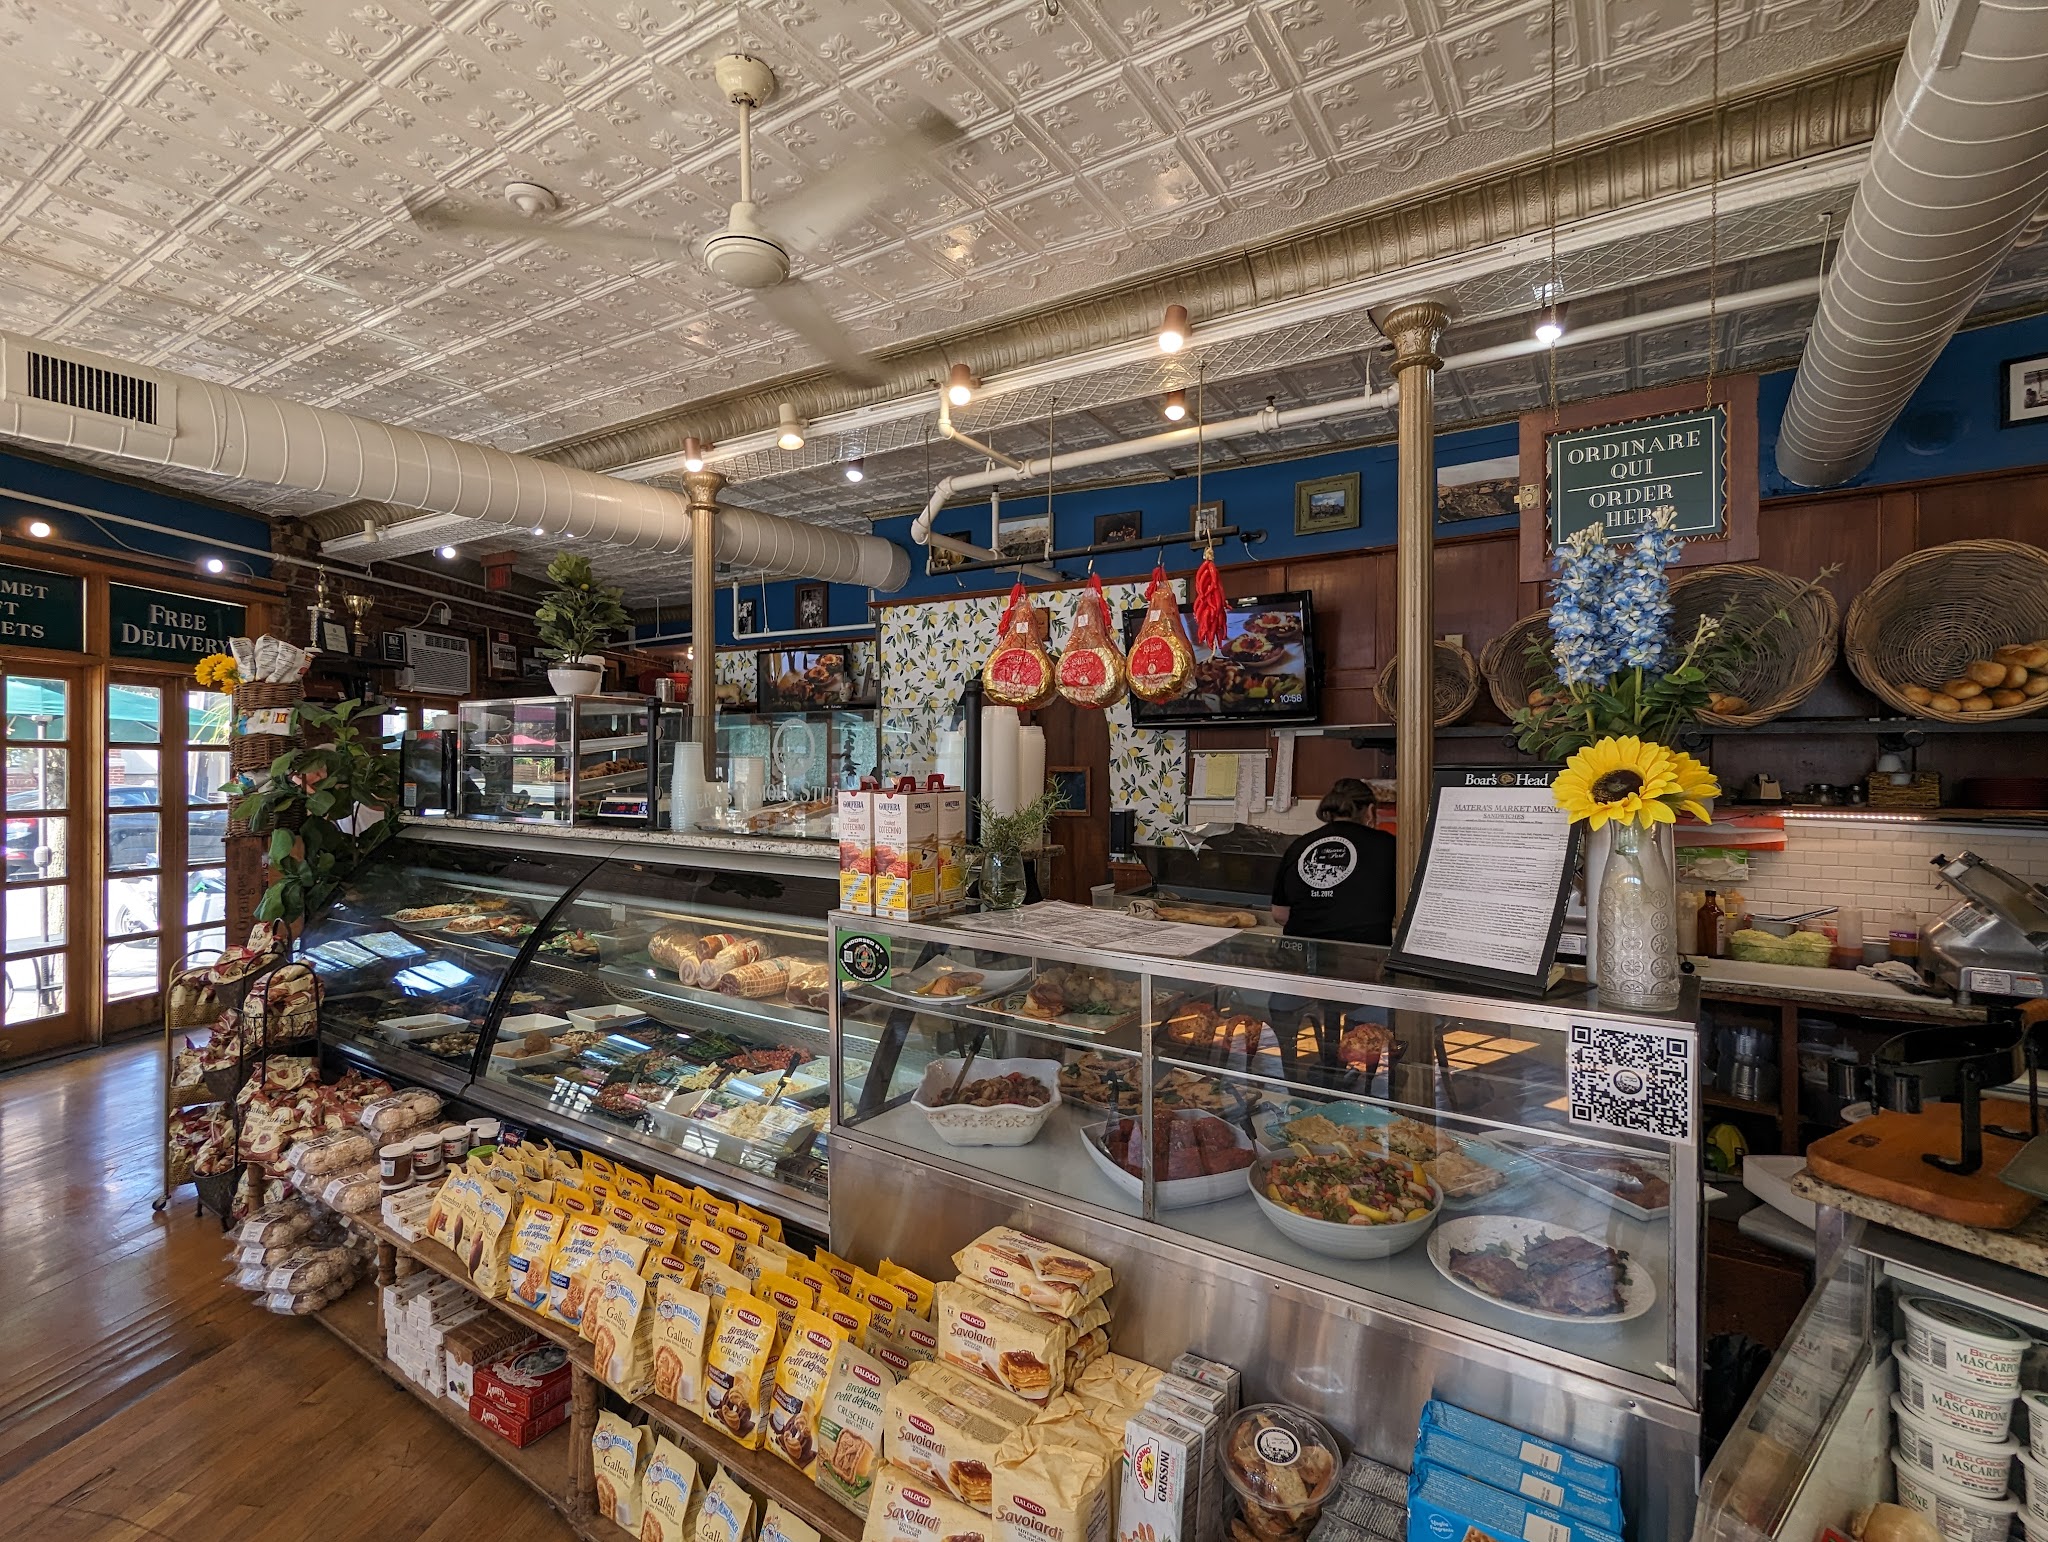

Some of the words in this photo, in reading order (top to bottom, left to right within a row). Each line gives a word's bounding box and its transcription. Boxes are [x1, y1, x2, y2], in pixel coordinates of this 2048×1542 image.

[1567, 430, 1701, 465] ORDINARE
[1610, 458, 1653, 480] QUI
[1588, 483, 1675, 509] ORDER
[1605, 505, 1657, 528] HER
[150, 603, 207, 632] FREE
[121, 622, 233, 655] DELIVERY
[1280, 694, 1303, 703] 10:58
[1465, 773, 1498, 786] Boar's
[1515, 772, 1549, 787] Head
[878, 803, 901, 814] GOLFERA
[1453, 804, 1494, 812] MATERA'S
[1494, 805, 1532, 813] MARKET
[878, 826, 902, 835] COTECHINO
[843, 937, 875, 950] ENDORSED
[874, 943, 885, 954] BY
[567, 1199, 584, 1211] BALOCCO
[536, 1210, 553, 1221] BALOCCO
[615, 1209, 633, 1221] BALOCCO
[527, 1223, 551, 1234] Breakfast
[579, 1225, 599, 1236] BALOCCO
[646, 1222, 665, 1235] BALOCCO
[728, 1227, 747, 1240] BALOCCO
[571, 1239, 595, 1249] Breakfast
[701, 1240, 720, 1255] BALOCCO
[662, 1257, 684, 1271] BALOCCO
[989, 1267, 1009, 1278] BALOCCO
[775, 1292, 798, 1308] BALOCCO
[869, 1295, 893, 1312] BALOCCO
[606, 1306, 628, 1331] Galletti
[738, 1309, 761, 1326] BALOCCO
[833, 1313, 858, 1330] BALOCCO
[960, 1313, 985, 1329] BALOCCO
[666, 1326, 694, 1350] Galletti
[728, 1326, 759, 1342] Breakfast
[808, 1332, 832, 1350] BALOCCO
[911, 1330, 936, 1347] BALOCCO
[950, 1322, 997, 1349] Savoiardi
[717, 1335, 735, 1344] Petit
[734, 1336, 761, 1355] déjeuner
[720, 1345, 752, 1367] GIRANDOLE
[784, 1356, 803, 1368] Petit
[796, 1348, 829, 1365] Breakfast
[881, 1350, 908, 1369] BALOCCO
[787, 1367, 820, 1391] GIRANDOLE
[854, 1365, 880, 1384] BALOCCO
[845, 1382, 881, 1402] Breakfast
[834, 1391, 853, 1403] Petit
[851, 1395, 884, 1417] déjeuner
[1931, 1393, 2008, 1421] MASCARPONE
[837, 1404, 876, 1431] CRUSCHELLE
[845, 1418, 863, 1431] BISCUITS
[909, 1415, 935, 1434] BALOCCO
[897, 1425, 946, 1457] Savoiardi
[602, 1455, 630, 1480] Galletti
[1134, 1446, 1152, 1490] GRANFORNO
[1158, 1451, 1170, 1502] GRISSINI
[650, 1490, 677, 1516] Galletti
[902, 1488, 931, 1507] BALOCCO
[1014, 1495, 1046, 1515] BALOCCO
[883, 1501, 941, 1534] Savoiardi
[995, 1504, 1065, 1542] Savoiardi
[1541, 1508, 1560, 1521] 250g
